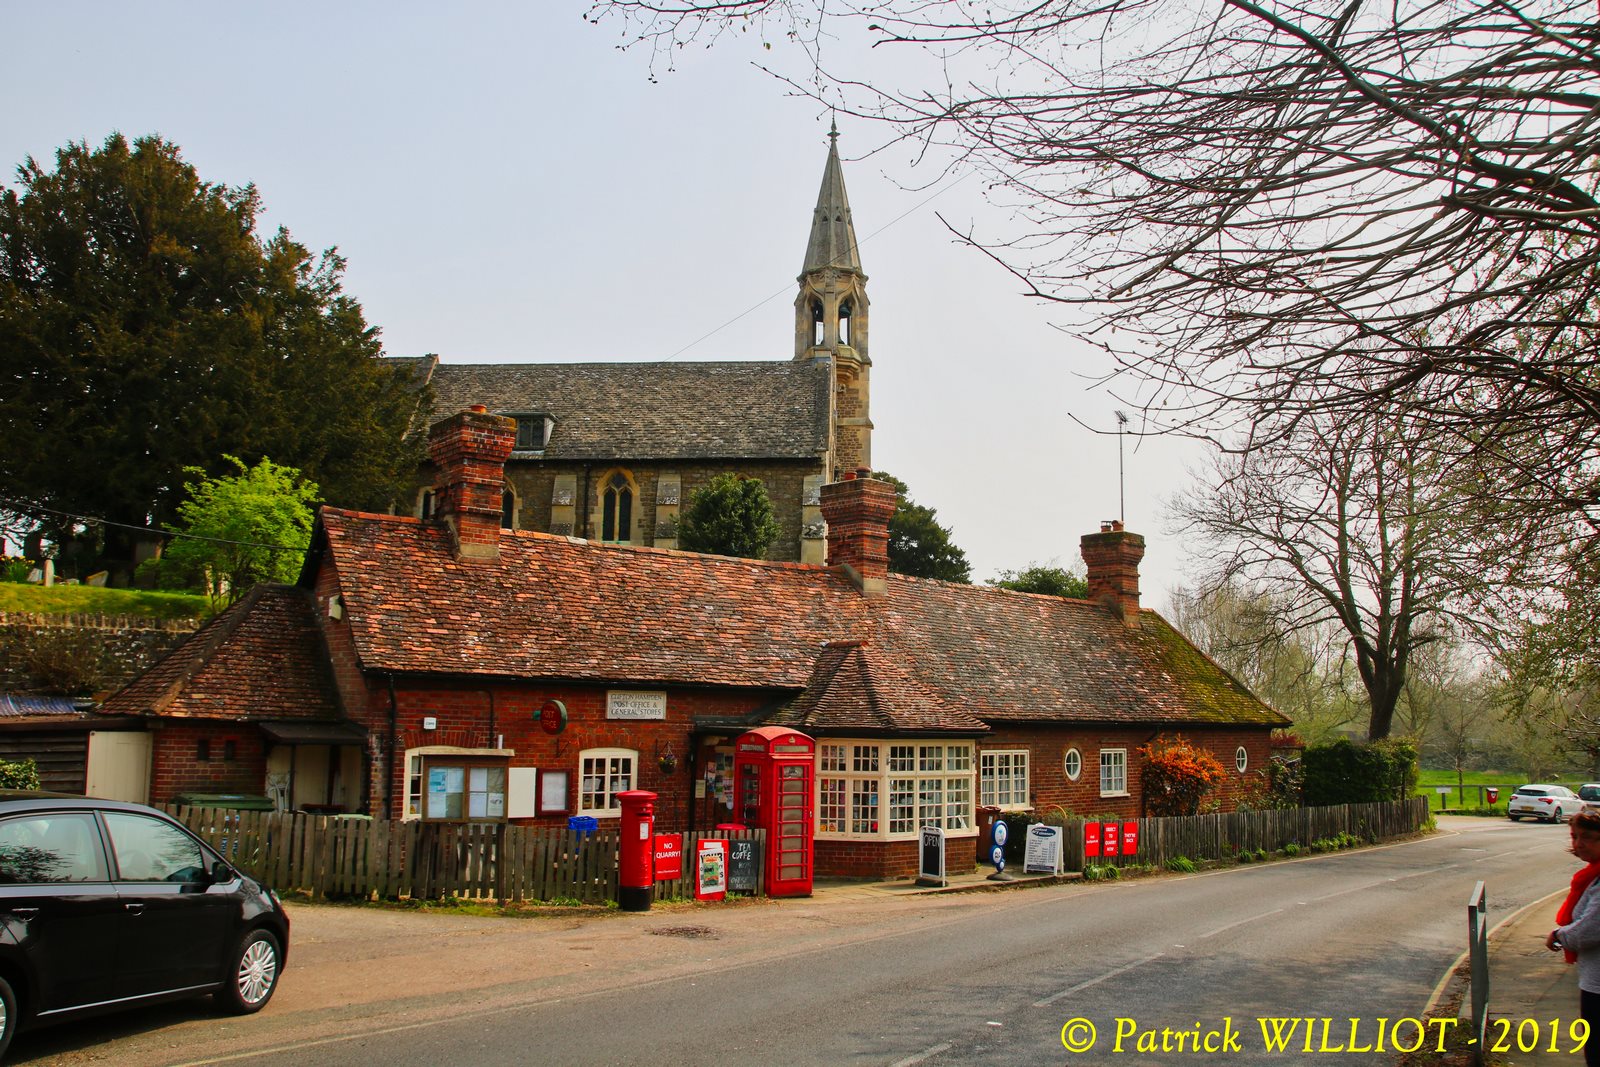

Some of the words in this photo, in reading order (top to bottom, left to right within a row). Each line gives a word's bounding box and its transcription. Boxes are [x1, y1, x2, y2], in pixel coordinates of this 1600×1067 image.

[924, 835, 939, 847] OPEN
[738, 843, 751, 851] TEA
[656, 851, 681, 859] QUARRY!
